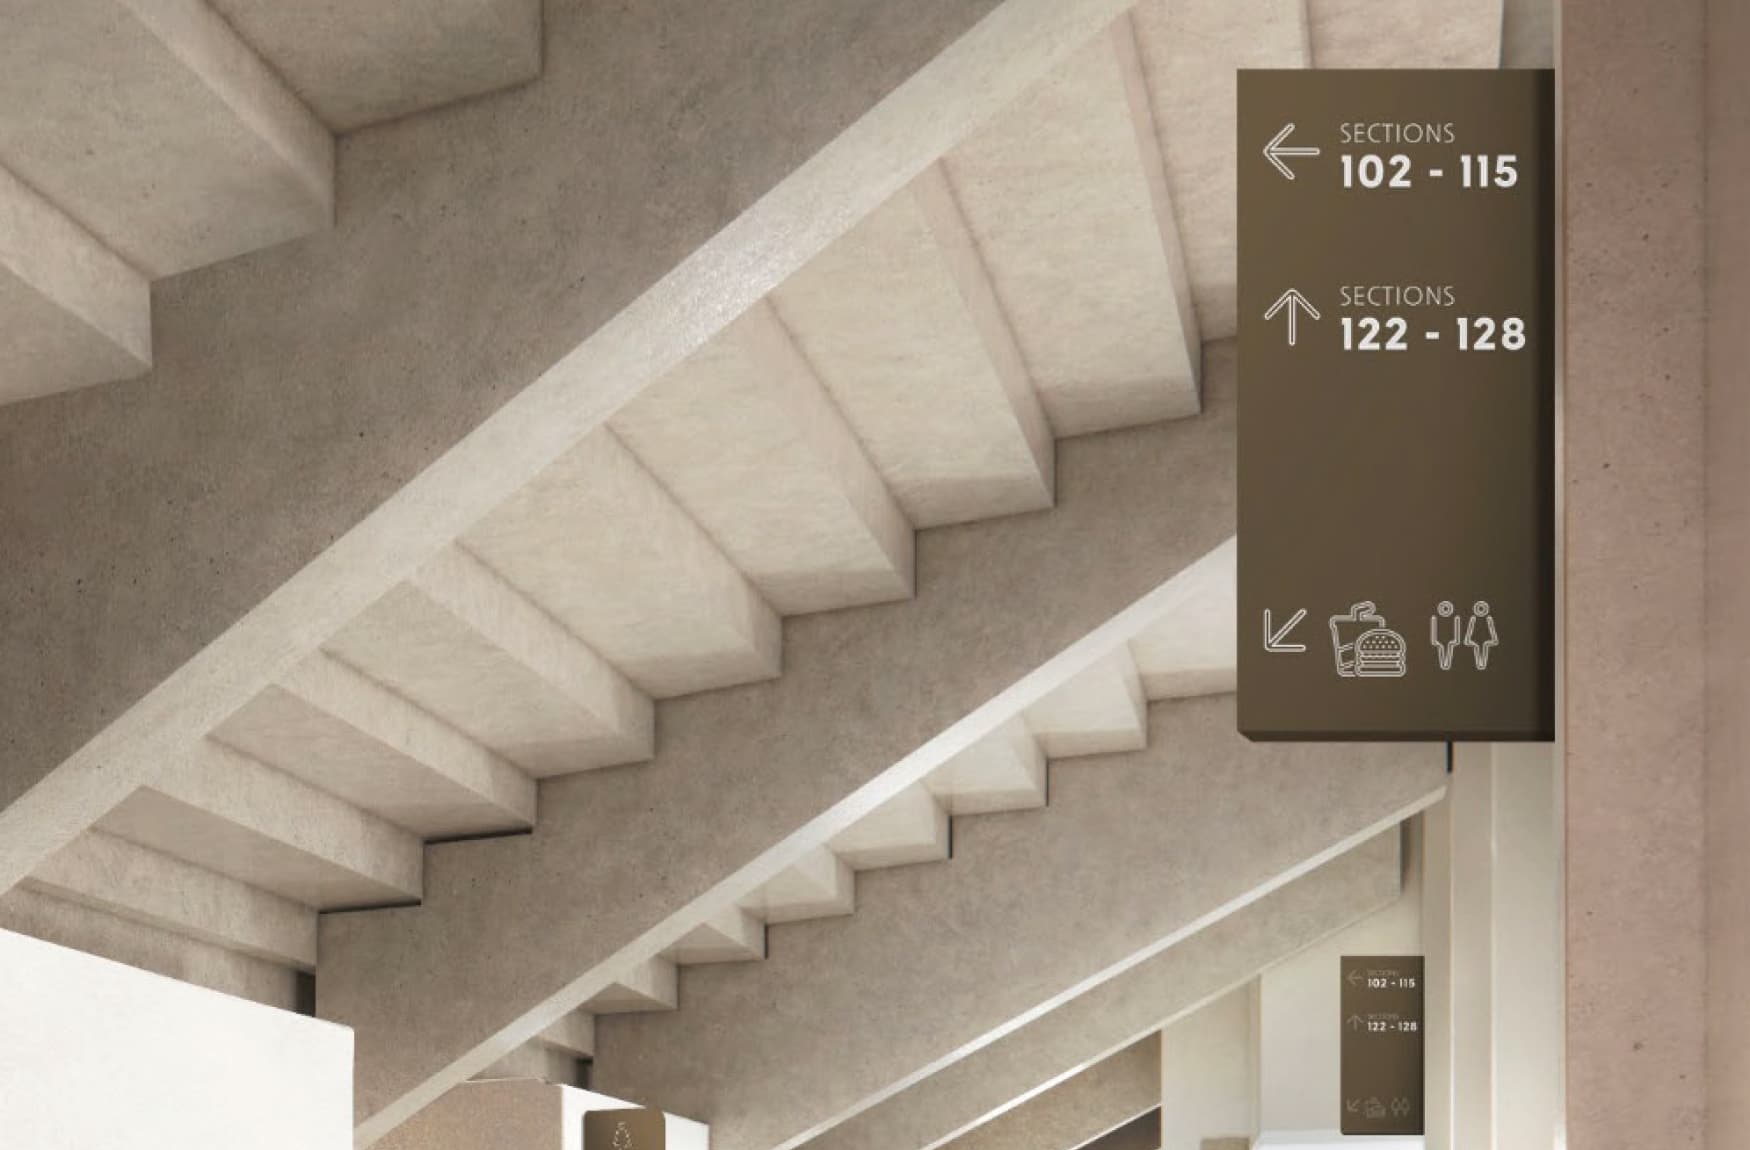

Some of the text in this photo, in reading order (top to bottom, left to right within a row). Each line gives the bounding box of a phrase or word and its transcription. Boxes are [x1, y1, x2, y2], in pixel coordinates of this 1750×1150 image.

[1340, 123, 1455, 144] SECTIONS
[1341, 154, 1412, 188] 102
[1460, 154, 1518, 188] 115
[1340, 286, 1455, 307] SECTIONS
[1341, 317, 1408, 351] 122
[1457, 317, 1526, 351] 128
[1367, 978, 1387, 988] 102
[1399, 978, 1416, 988] 115
[1367, 1021, 1386, 1031] 122
[1398, 1021, 1417, 1031] 128
